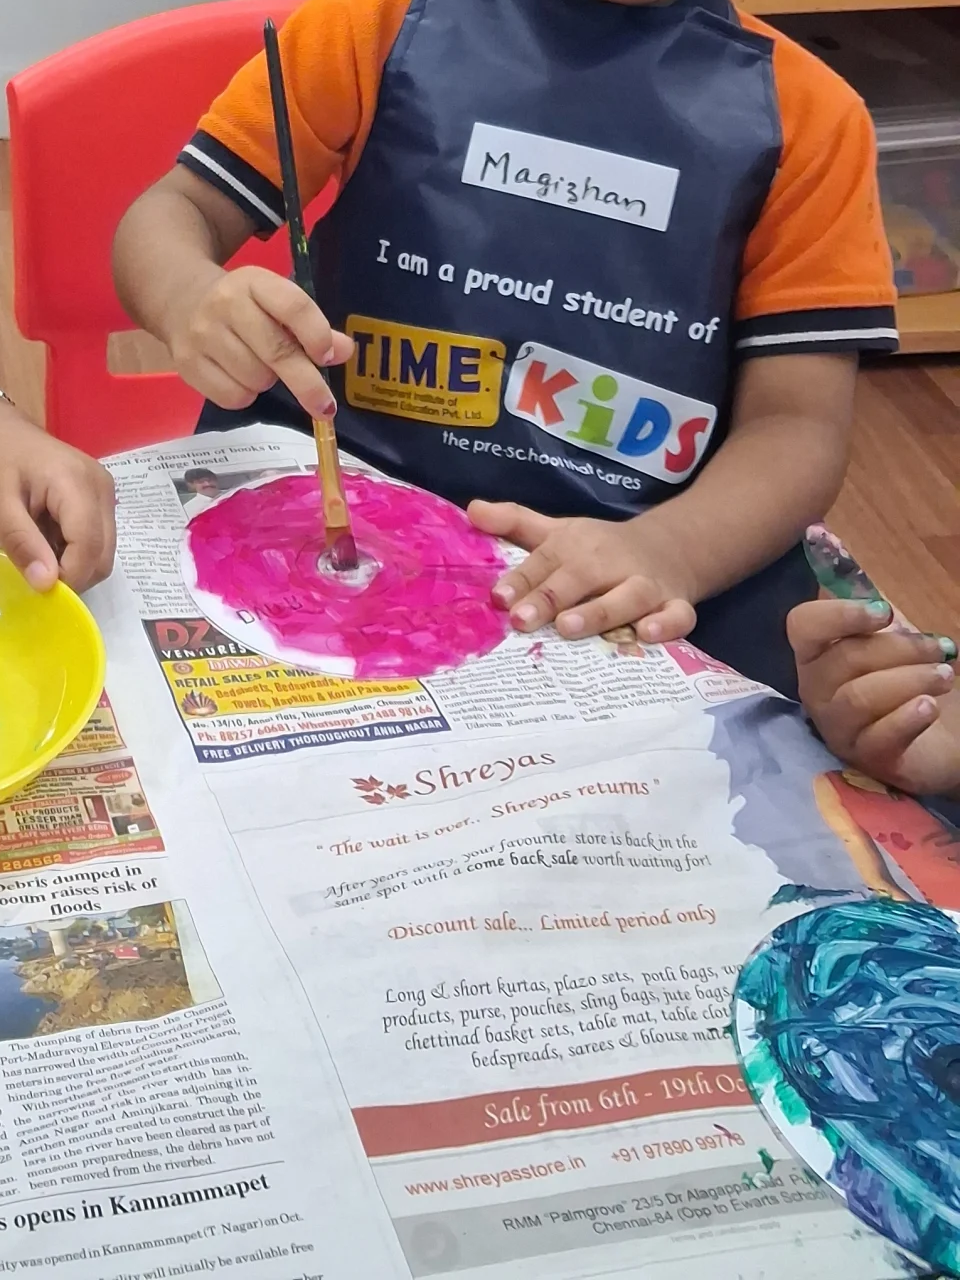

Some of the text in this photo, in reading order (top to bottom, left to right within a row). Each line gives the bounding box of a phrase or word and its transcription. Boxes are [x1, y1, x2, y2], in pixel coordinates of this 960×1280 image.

[479, 152, 646, 217] Magizhan
[377, 239, 720, 346] I am a proud student of
[134, 444, 281, 465] for donation of books to
[147, 456, 229, 472] college hostel
[442, 428, 469, 452] the
[596, 465, 641, 491] cares
[175, 670, 280, 688] RETAIL SALES AT
[203, 720, 443, 760] FREE DELIVERY THOROUGHOUT ANNA NAGAR
[414, 752, 556, 796] Shreyas
[33, 806, 79, 815] PRODUCTS
[368, 835, 410, 849] wait
[415, 830, 429, 840] is
[491, 791, 572, 819] Shreyas
[53, 867, 120, 885] dumped
[125, 865, 142, 875] in
[467, 858, 504, 872] come
[510, 850, 551, 868] back
[551, 851, 578, 865] sale
[584, 852, 624, 867] worth
[627, 856, 683, 872] waiting
[51, 886, 100, 900] raises
[104, 880, 137, 894] risk
[142, 877, 158, 889] of
[50, 902, 102, 916] floods
[387, 915, 477, 942] Discount
[541, 912, 610, 931] Limited
[615, 909, 672, 933] period
[677, 904, 717, 924] only
[385, 988, 426, 1007] Long
[454, 979, 492, 997] short
[497, 977, 550, 997] kurtas,
[554, 974, 596, 997] plazo
[602, 971, 634, 984] sets,
[642, 968, 675, 985] potli
[679, 965, 718, 982] bags,
[485, 1071, 746, 1128] Sale from 6th 19th Oc
[30, 1178, 58, 1190] been
[61, 1168, 111, 1185] removed
[113, 1164, 140, 1177] from
[143, 1161, 162, 1173] the
[405, 1155, 586, 1197] www.shreyasstore.in
[611, 1147, 640, 1163] +91
[642, 1138, 693, 1160] 97890
[14, 1207, 76, 1231] opens
[82, 1200, 103, 1220] in
[109, 1172, 270, 1216] Kannammapet
[503, 1215, 542, 1231] RMM
[632, 1196, 664, 1212] 23/5
[665, 1192, 683, 1205] Dr
